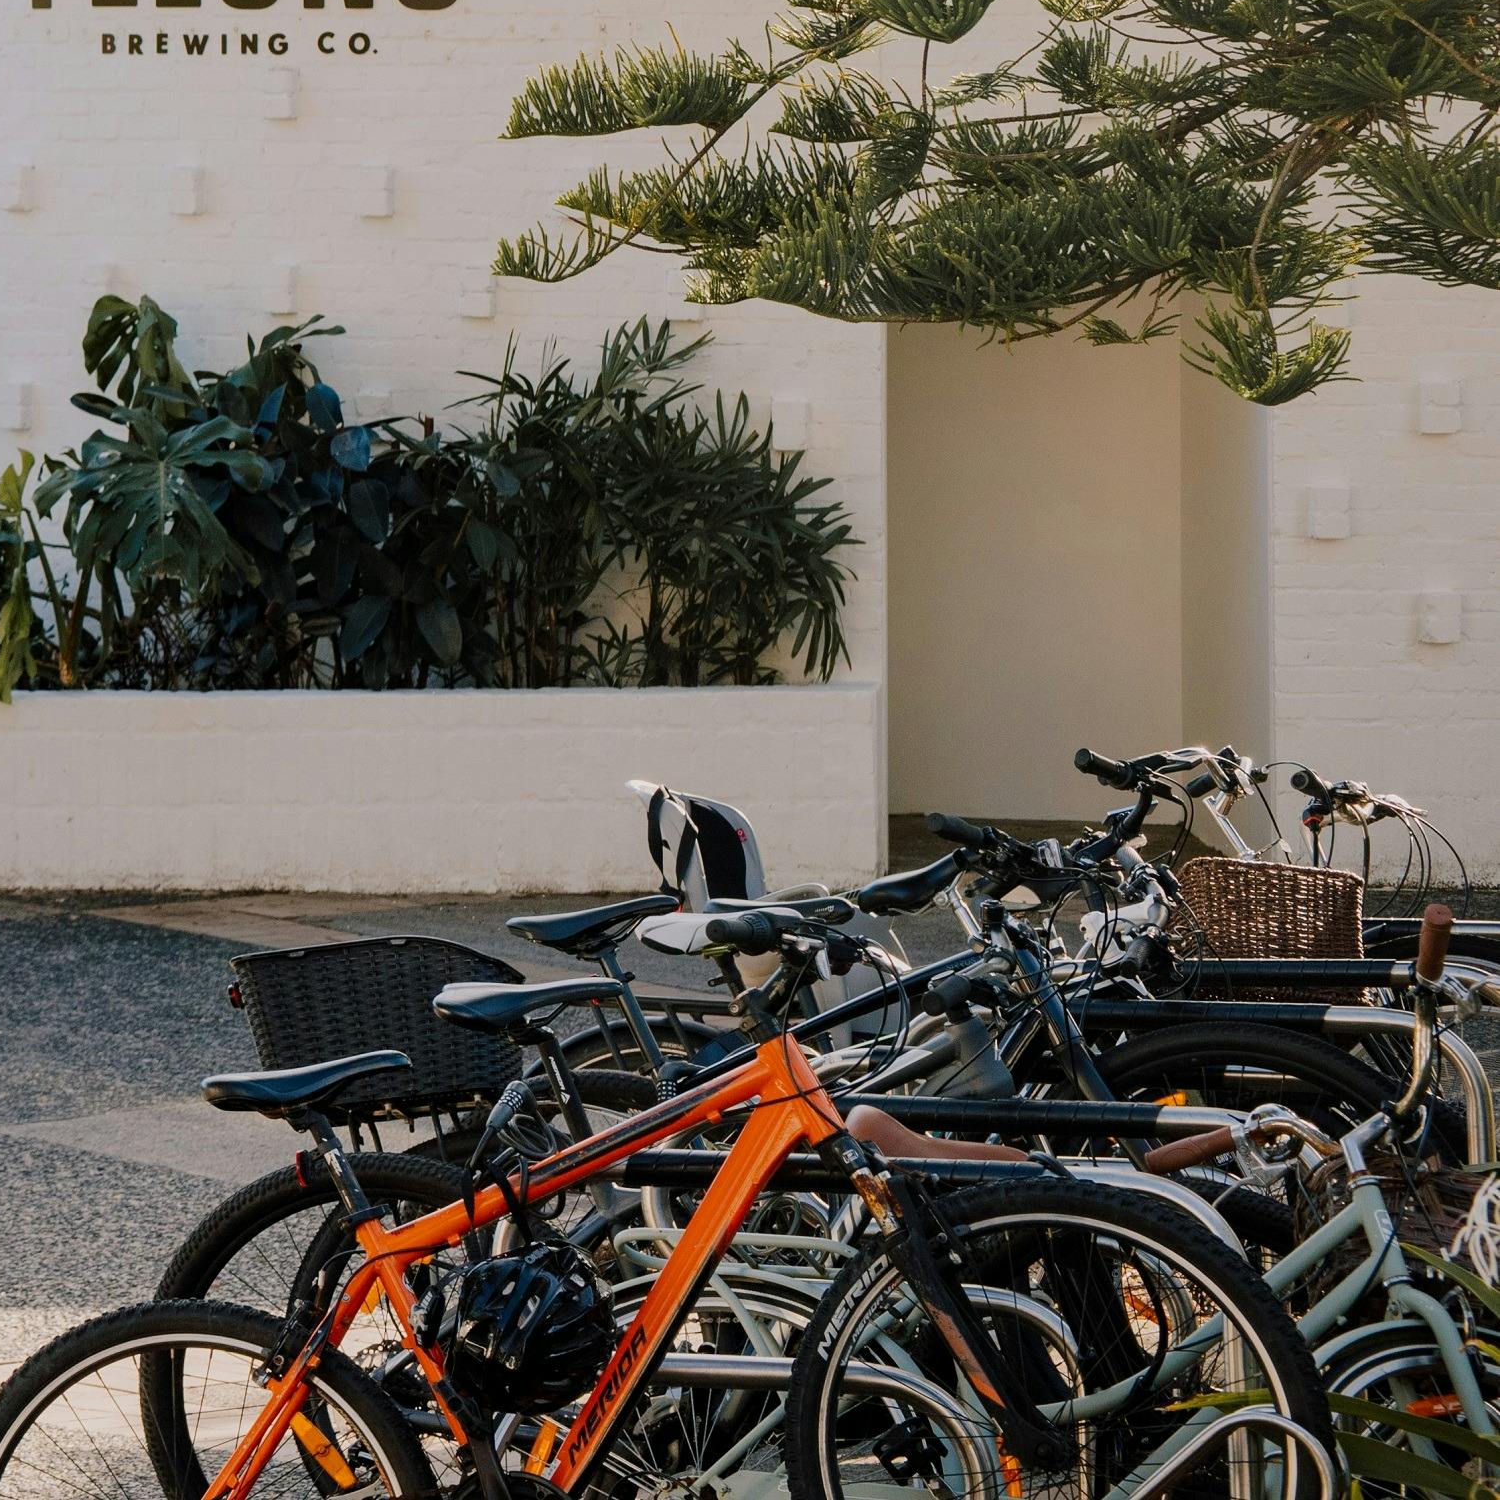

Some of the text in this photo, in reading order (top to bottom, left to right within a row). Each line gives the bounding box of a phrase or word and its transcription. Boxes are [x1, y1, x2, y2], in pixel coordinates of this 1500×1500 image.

[101, 31, 378, 55] BREWING CO.
[817, 1253, 892, 1361] MERID
[568, 1323, 648, 1469] MERIDA
